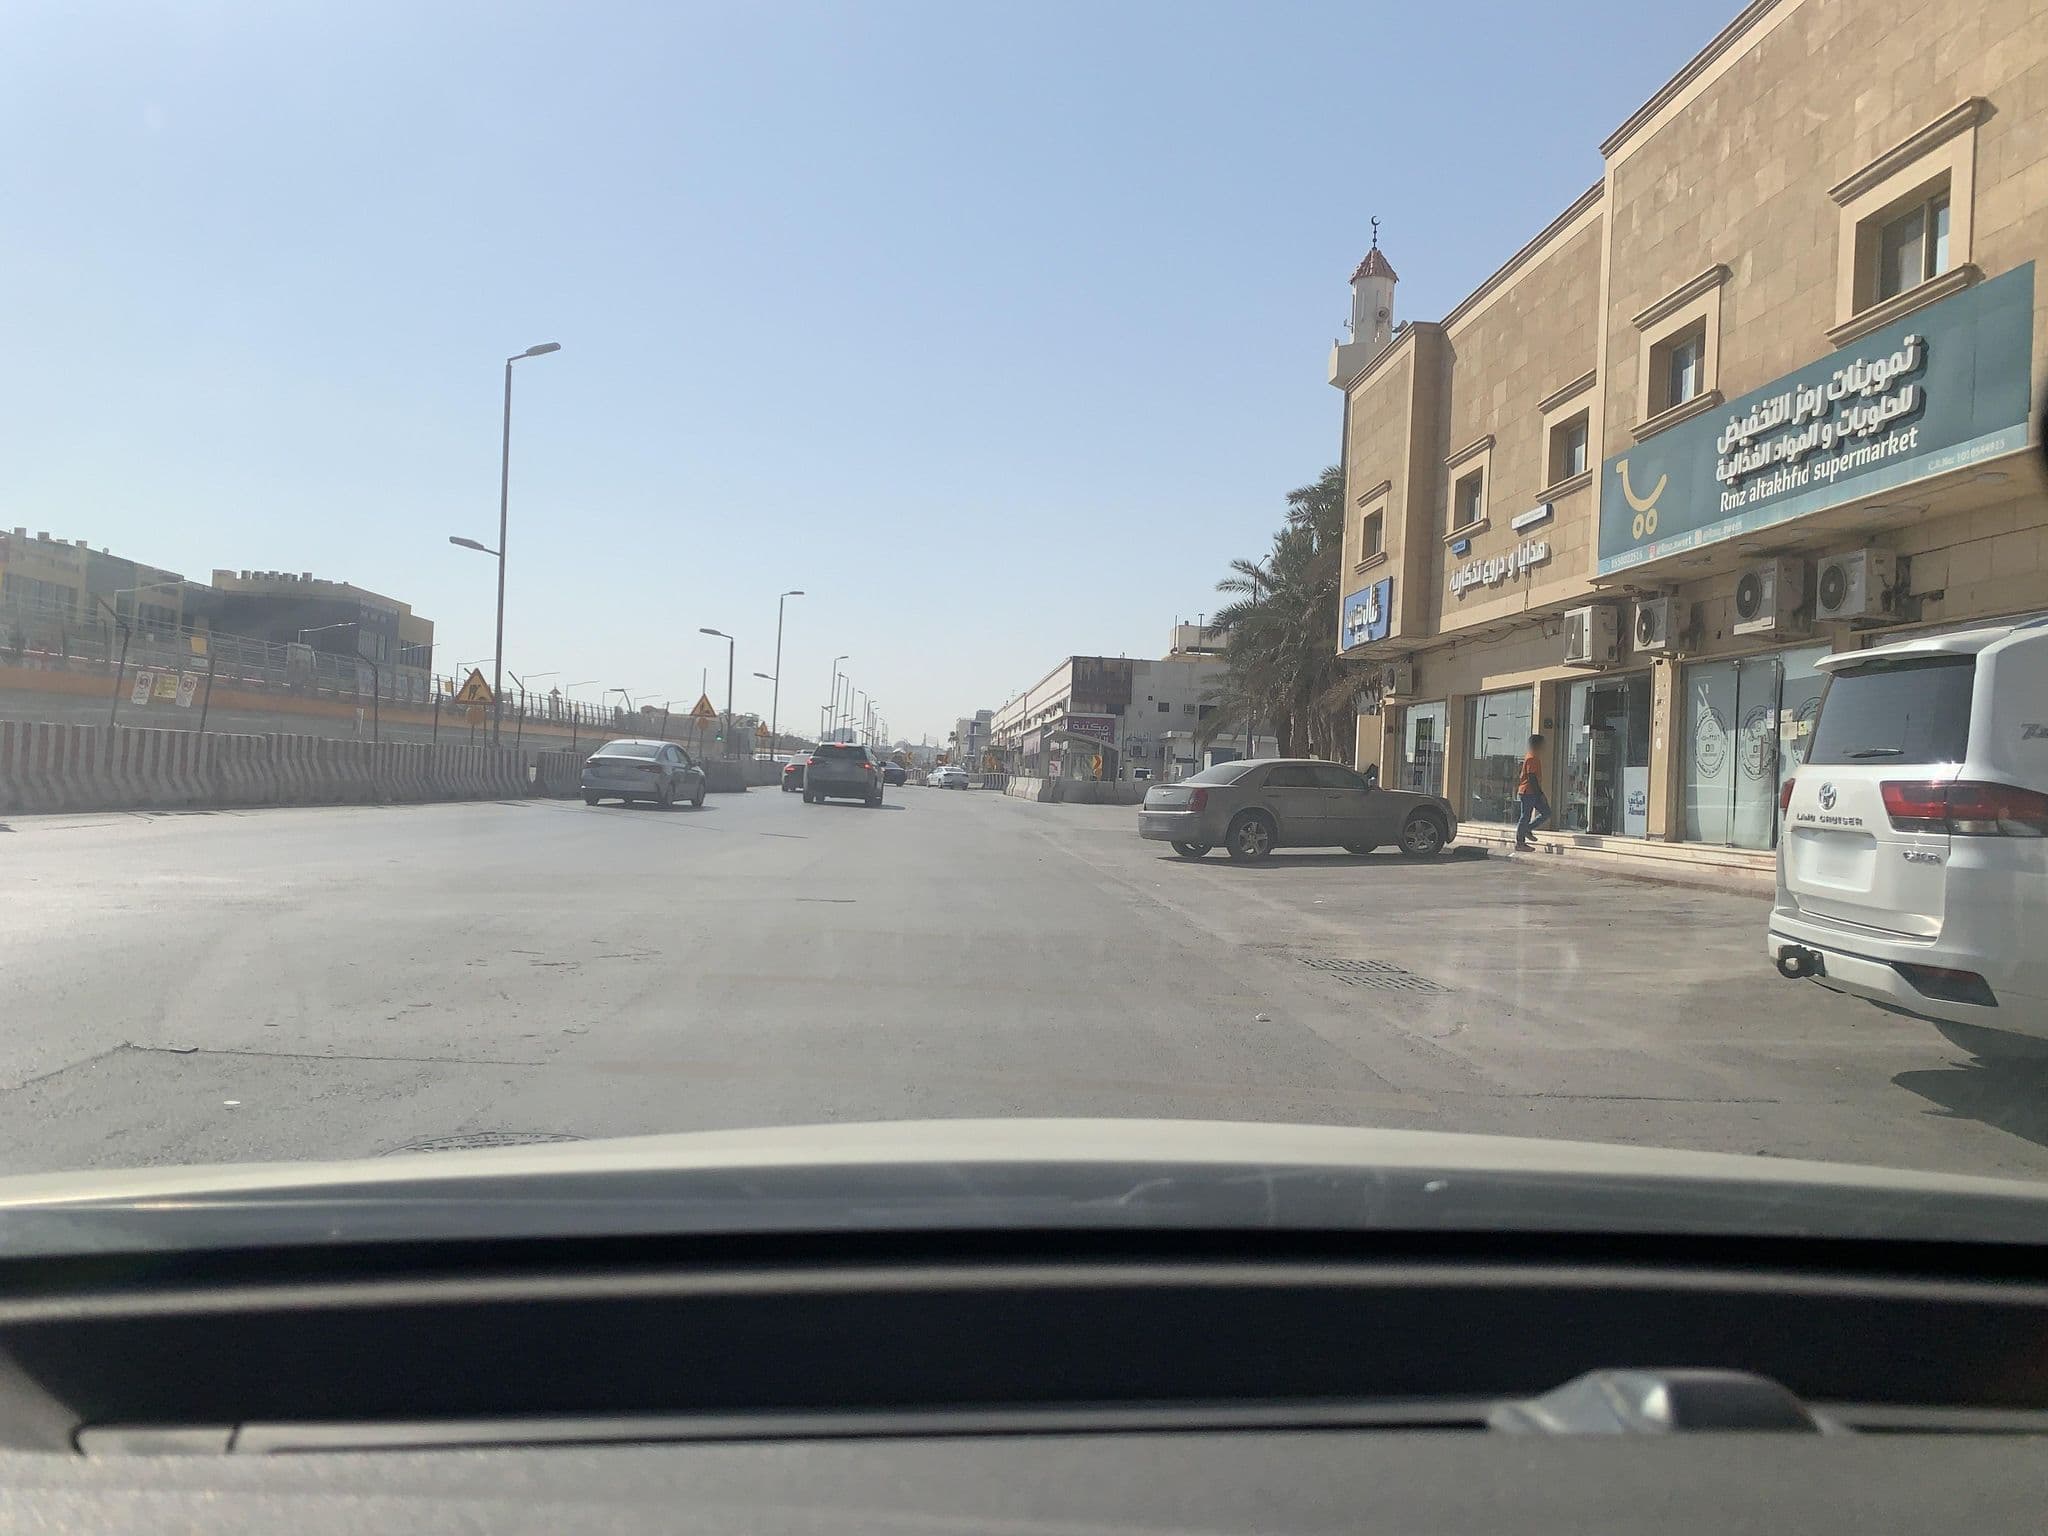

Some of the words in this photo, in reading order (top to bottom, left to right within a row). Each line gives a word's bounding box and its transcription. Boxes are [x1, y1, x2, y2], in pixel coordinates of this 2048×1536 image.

[1827, 334, 1921, 400] تموينات
[1717, 393, 1790, 454] التخفيض
[1792, 384, 1824, 425] رمز
[1836, 385, 1920, 437] للحلويات
[1773, 423, 1820, 462] المواد
[1822, 424, 1833, 449] و
[1720, 491, 1746, 512] Rmz
[1749, 462, 1809, 502] altakhfid
[1813, 426, 1919, 483] supermarket
[1483, 556, 1505, 584] دروع
[1508, 552, 1514, 577] و
[1518, 540, 1545, 573] هدايا
[1073, 721, 1109, 734] مكتبة
